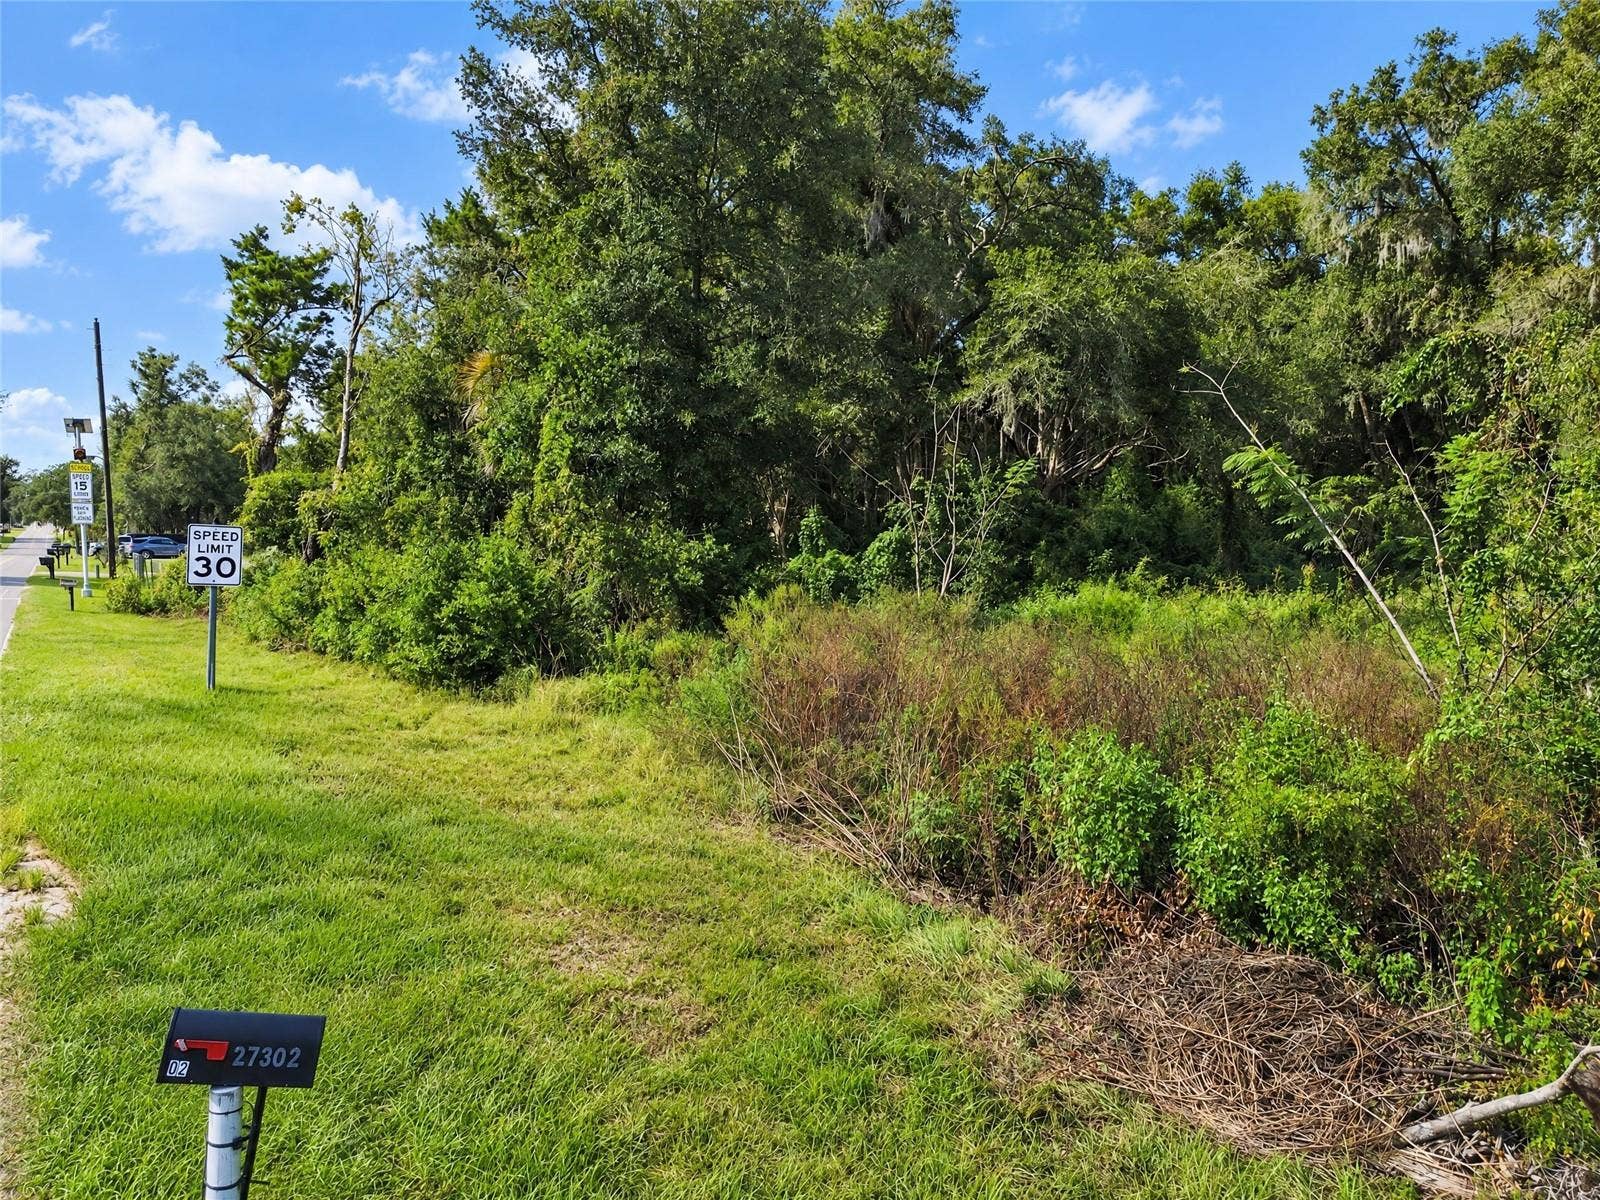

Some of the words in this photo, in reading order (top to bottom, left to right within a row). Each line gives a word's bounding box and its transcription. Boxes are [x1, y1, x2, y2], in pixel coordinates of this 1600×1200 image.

[74, 481, 88, 491] 15
[193, 530, 239, 542] SPEED
[197, 543, 234, 554] LIMIT
[193, 556, 237, 578] 30
[232, 1045, 302, 1068] 27302
[167, 1060, 189, 1077] 02
